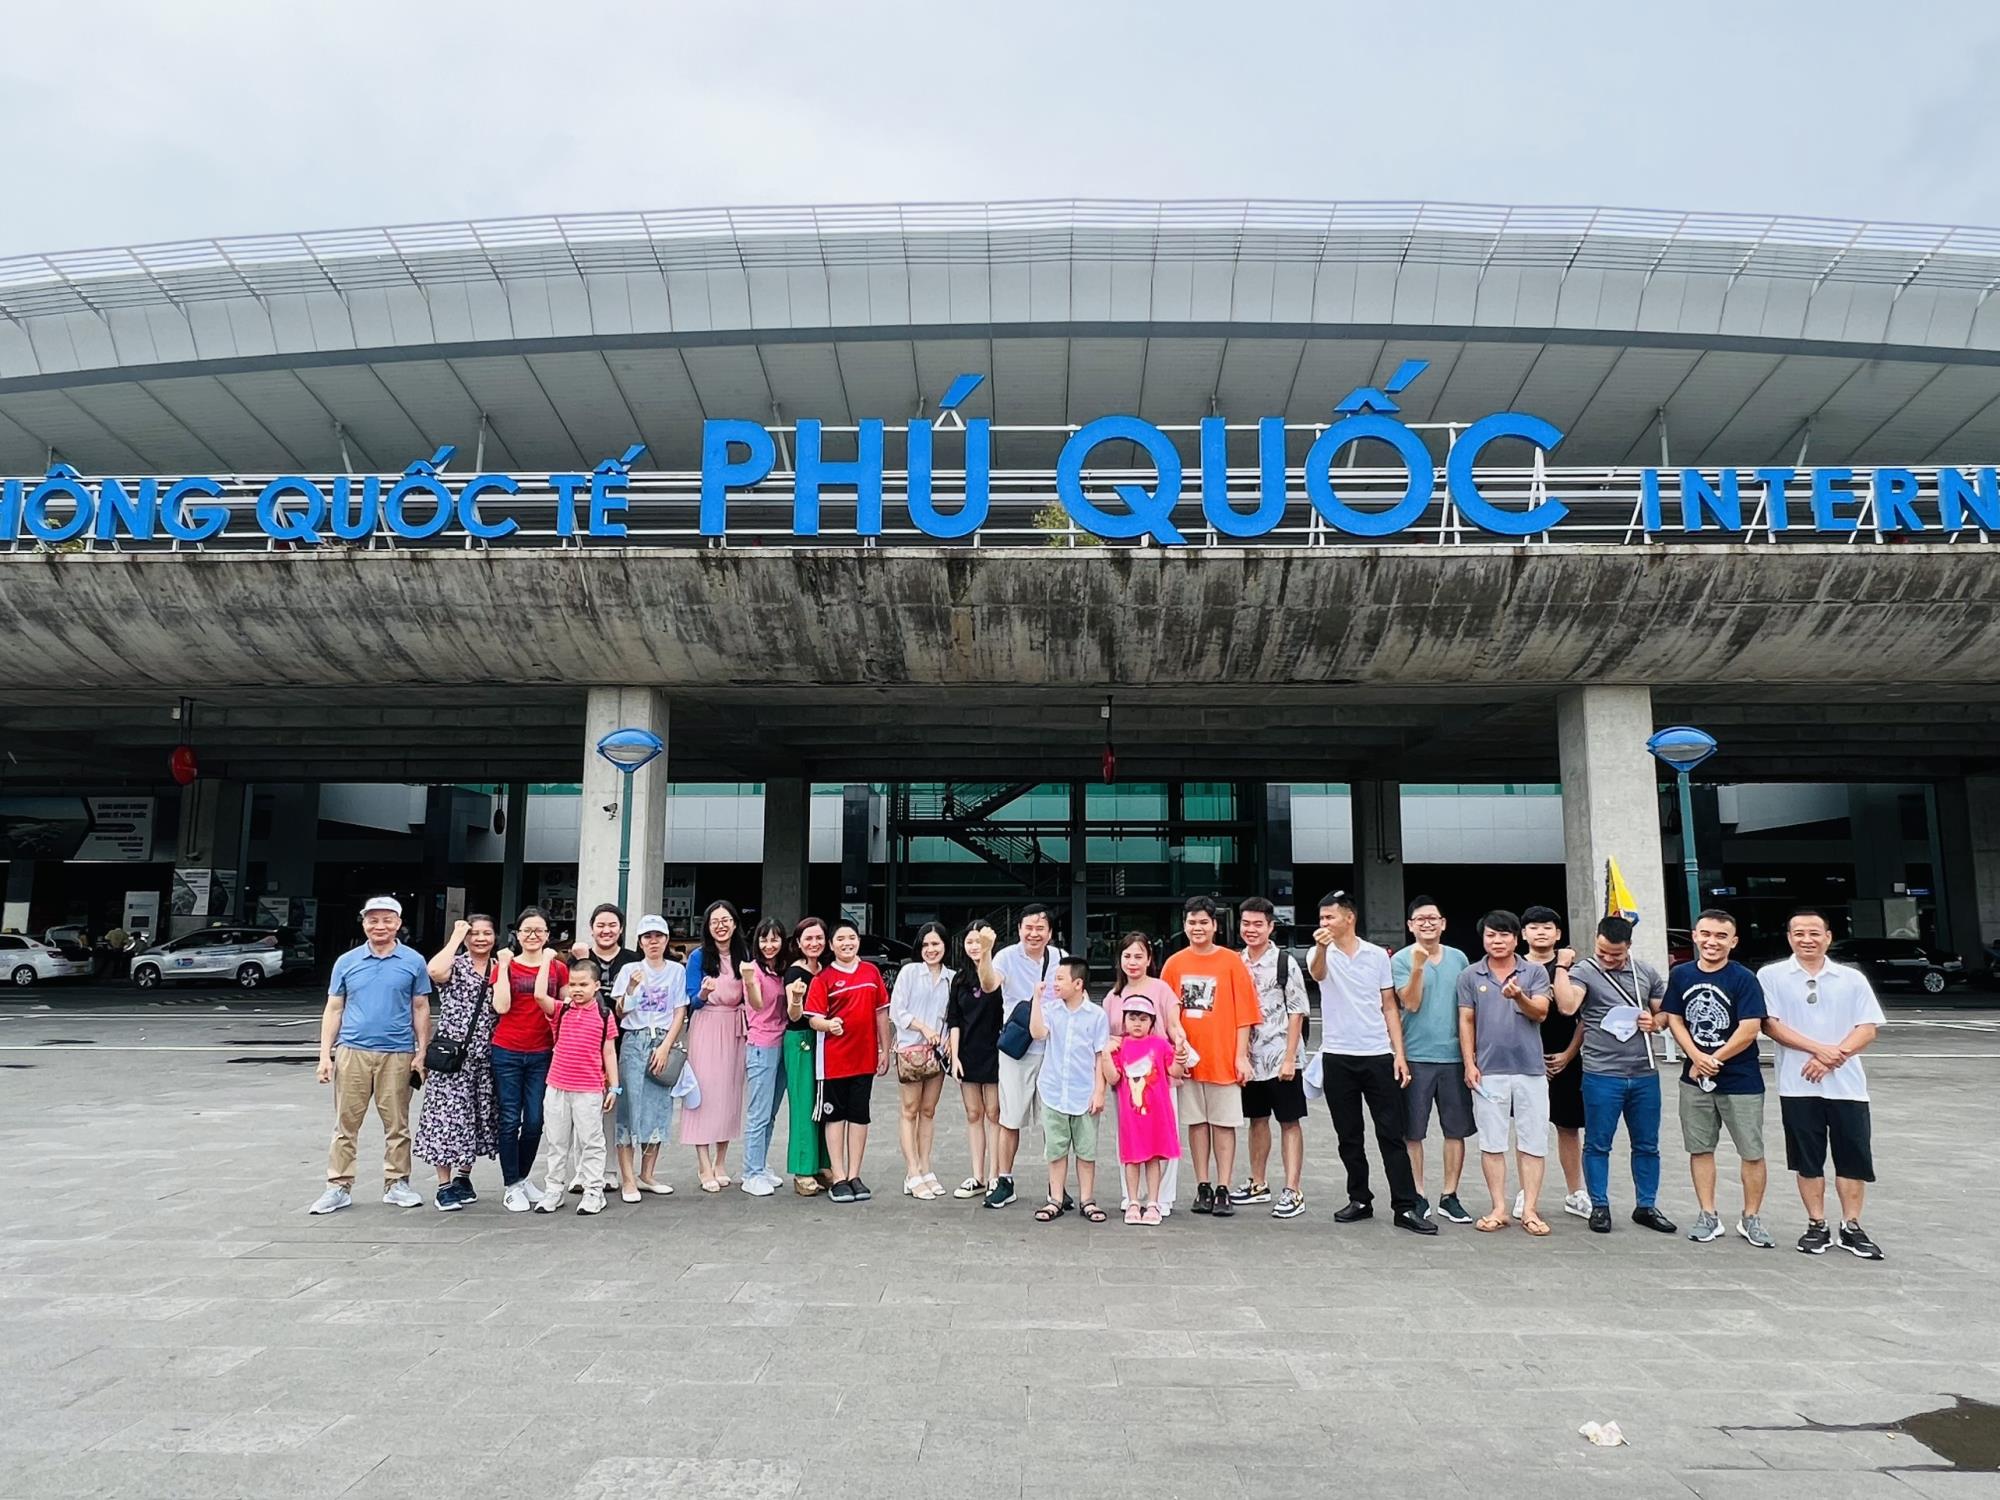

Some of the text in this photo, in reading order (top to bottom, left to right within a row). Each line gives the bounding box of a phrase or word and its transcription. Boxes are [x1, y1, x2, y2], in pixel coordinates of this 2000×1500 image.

[256, 445, 519, 544] QUỐC
[548, 443, 647, 538] TẾ
[699, 374, 991, 538] PHÚ
[1055, 359, 1570, 545] QUỐC
[1641, 467, 2000, 532] INTERN
